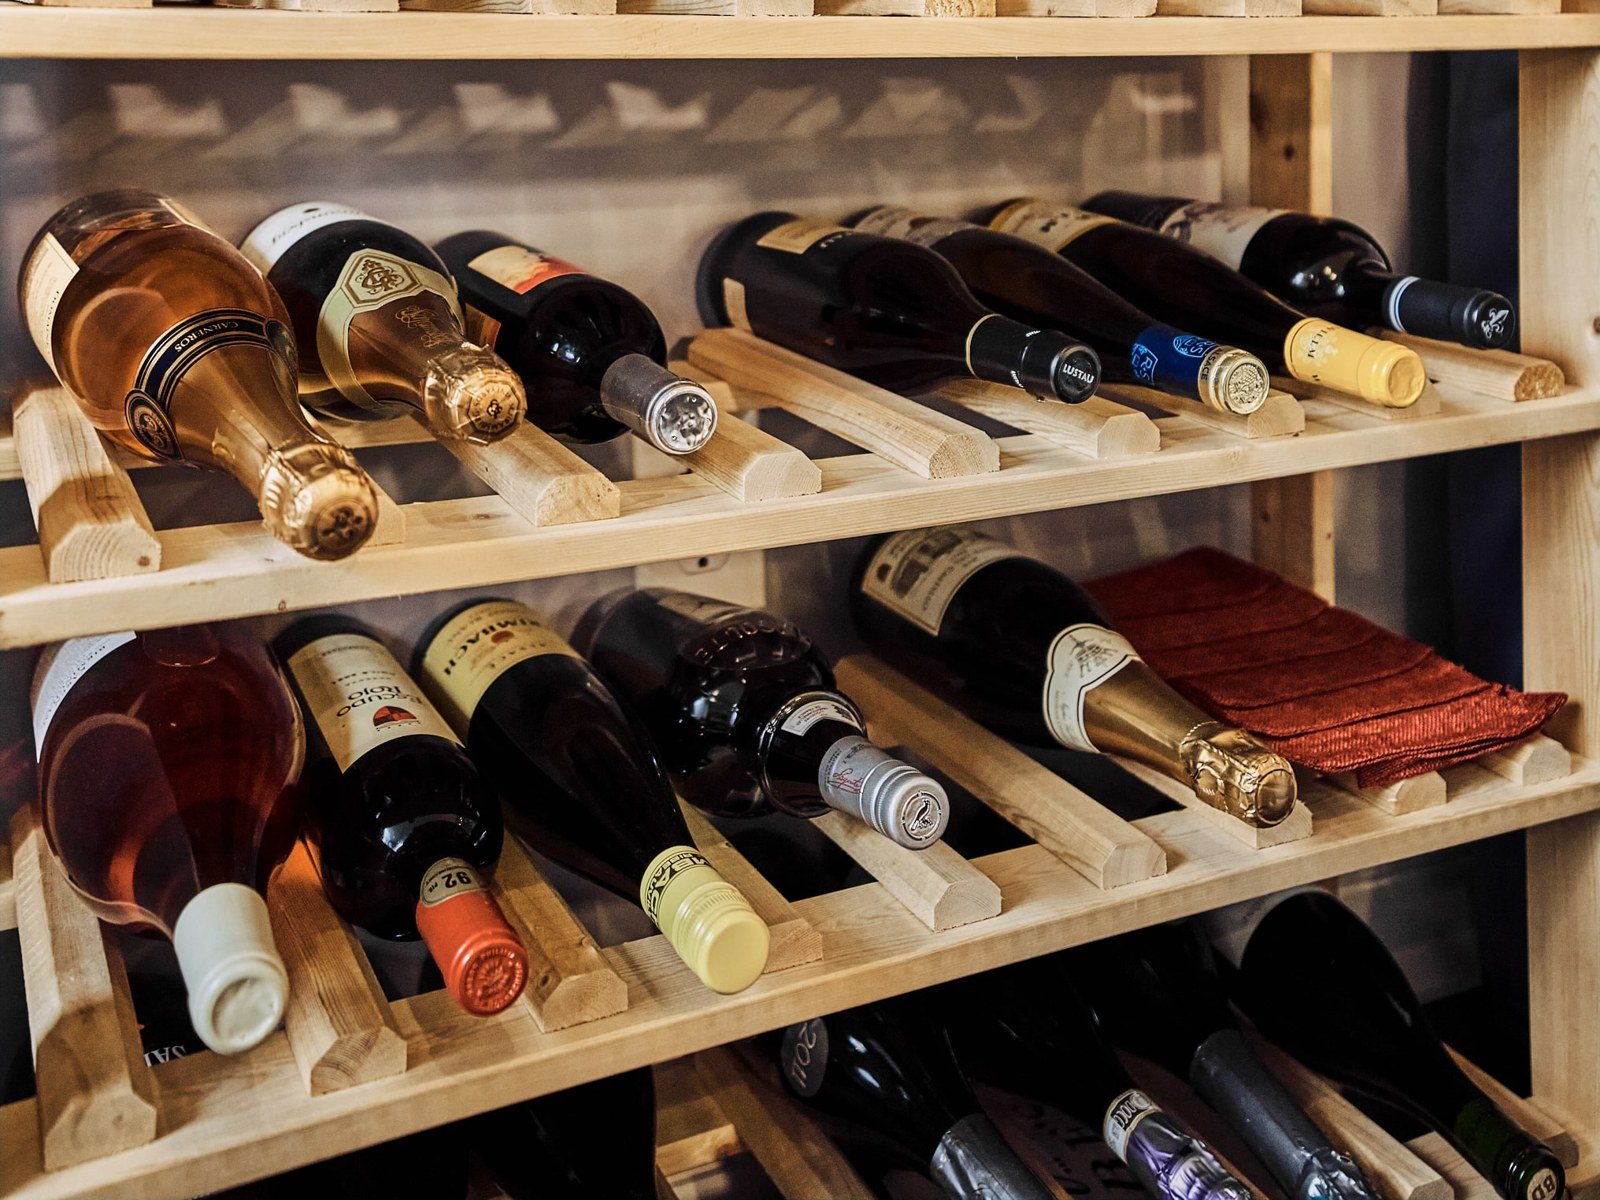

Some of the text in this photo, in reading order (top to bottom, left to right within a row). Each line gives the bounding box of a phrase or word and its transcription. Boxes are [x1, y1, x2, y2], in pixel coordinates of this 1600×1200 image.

[174, 319, 239, 353] CARNEROS
[1062, 362, 1095, 384] LUSTAU
[1201, 347, 1224, 381] ALSACE
[347, 685, 401, 701] ROJO
[336, 693, 423, 718] ESCUDO
[442, 871, 472, 889] 92
